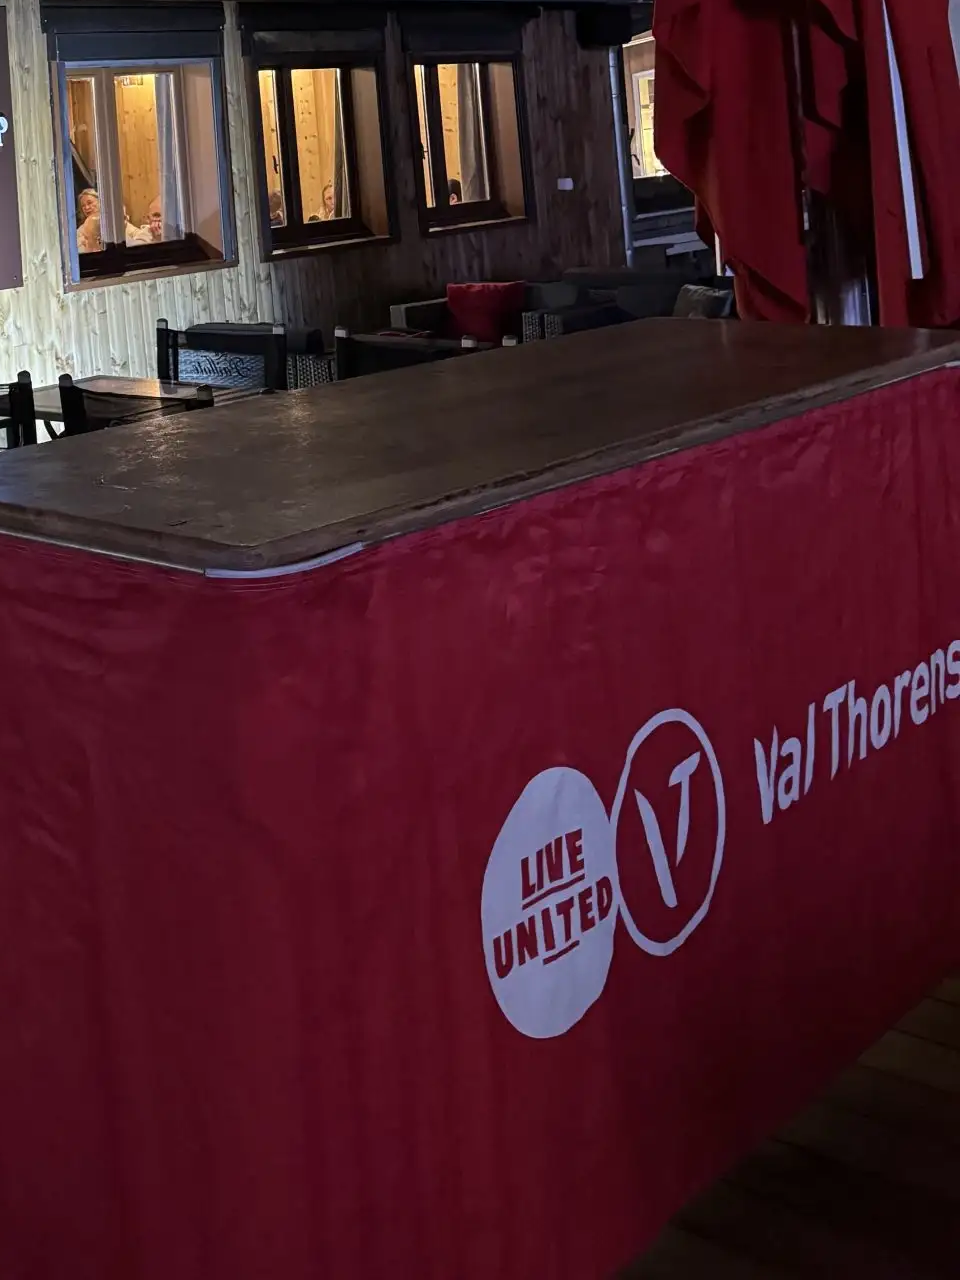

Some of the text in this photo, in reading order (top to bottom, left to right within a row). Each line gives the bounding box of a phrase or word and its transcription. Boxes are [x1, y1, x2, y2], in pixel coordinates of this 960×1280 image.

[753, 639, 960, 825] Val Thorens
[521, 828, 585, 900] LIVE
[493, 876, 614, 979] UNITED
